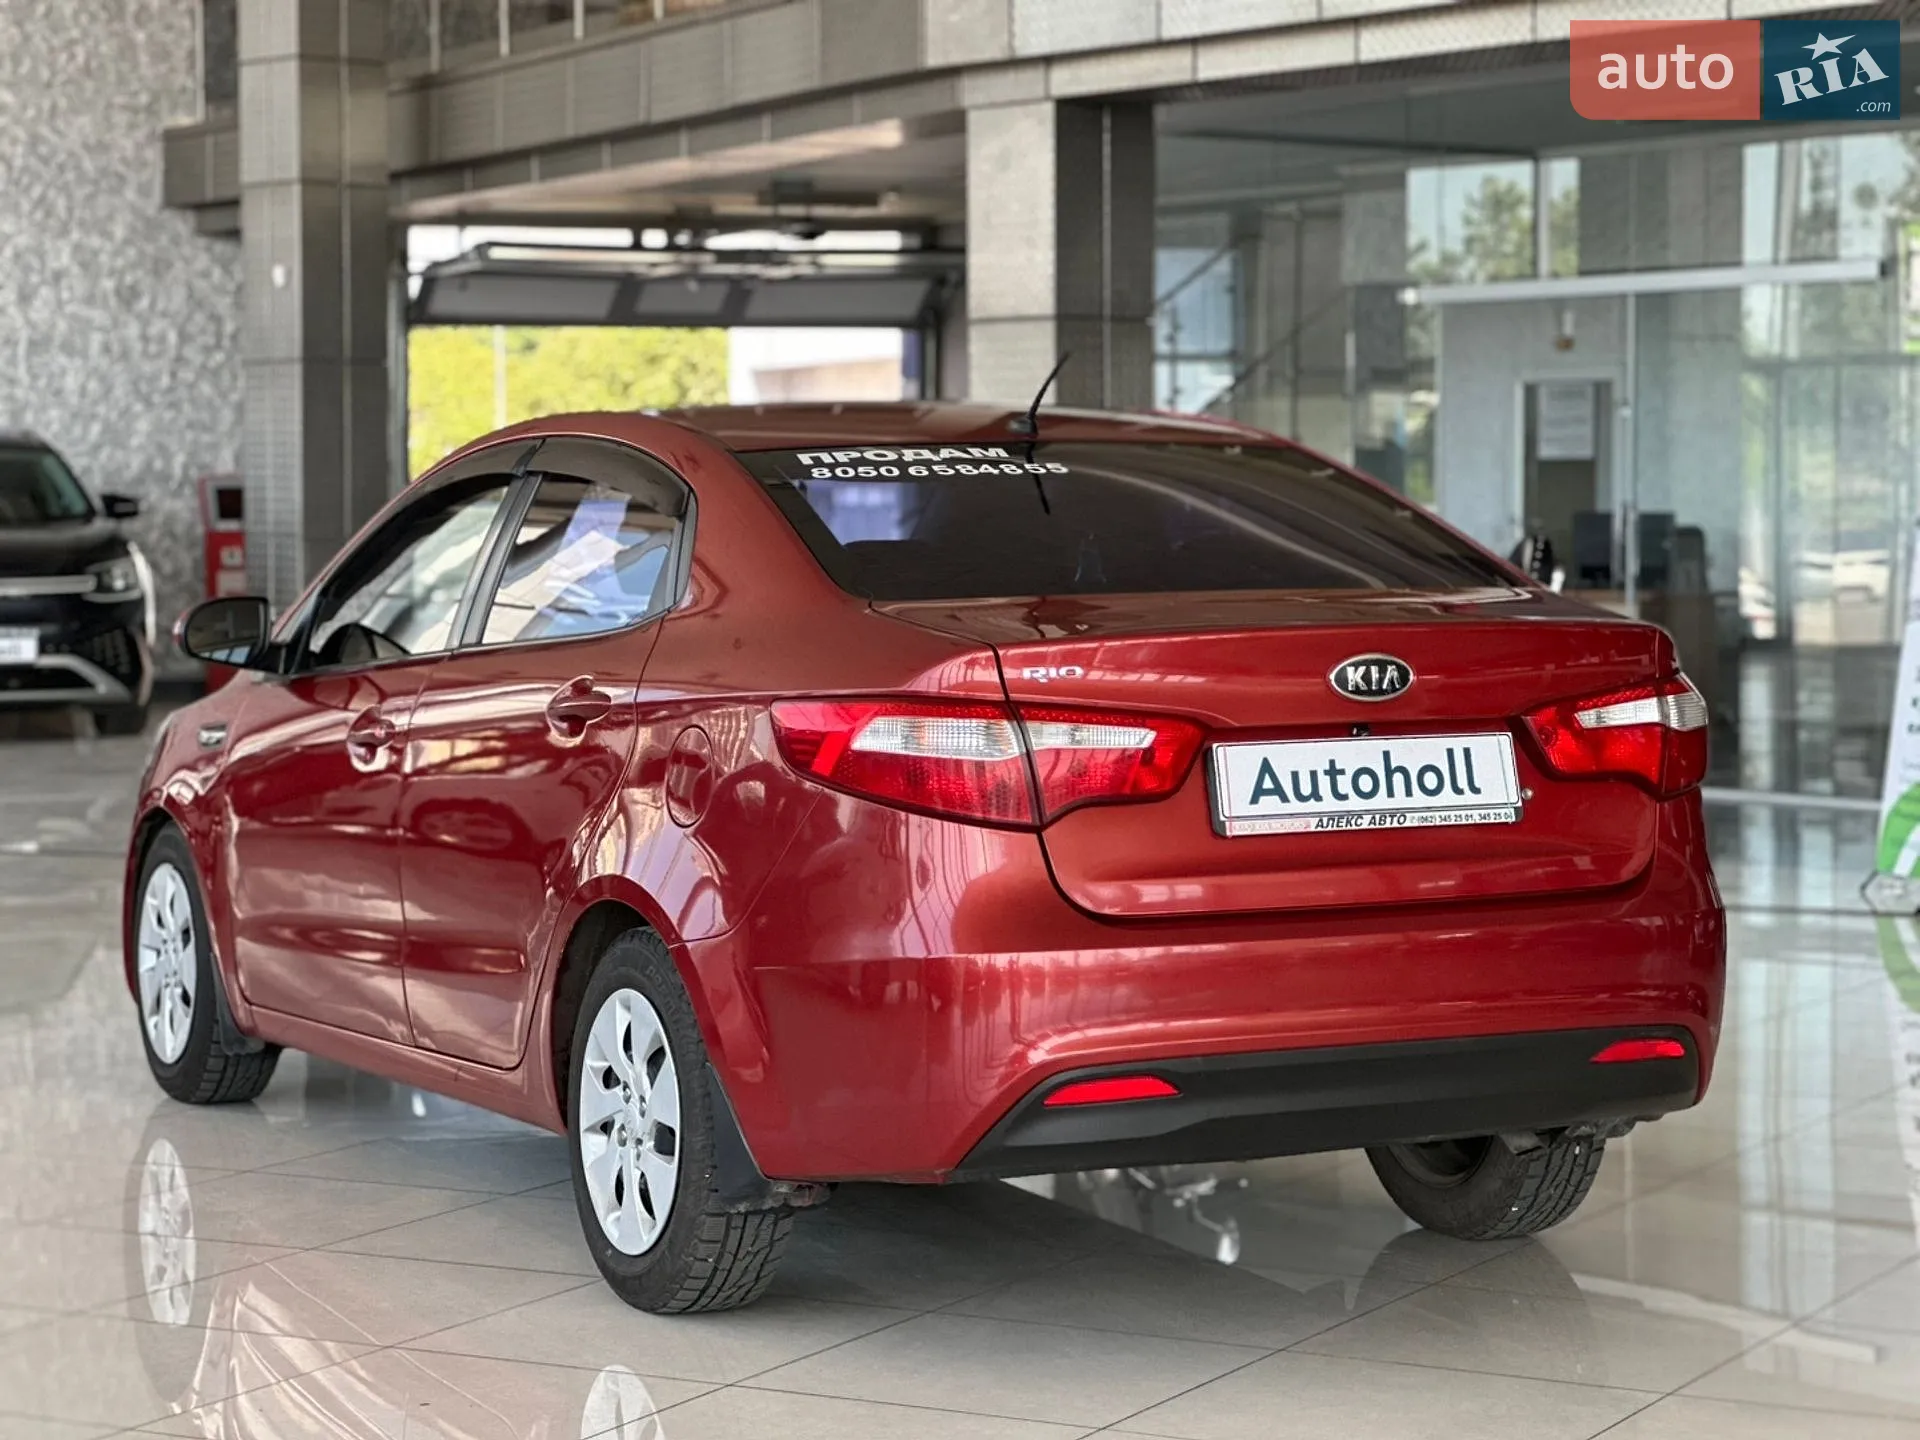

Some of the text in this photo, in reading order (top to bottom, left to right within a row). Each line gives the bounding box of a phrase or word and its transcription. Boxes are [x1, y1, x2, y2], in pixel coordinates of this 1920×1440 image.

[796, 446, 1010, 465] ПРОДАМ
[810, 462, 1070, 479] 8050 6584855
[1021, 665, 1084, 683] RIO
[1345, 665, 1402, 692] KIA
[1248, 746, 1482, 806] Autoholl
[1314, 815, 1364, 830] АЛЕКС
[1368, 813, 1408, 828] АВТО
